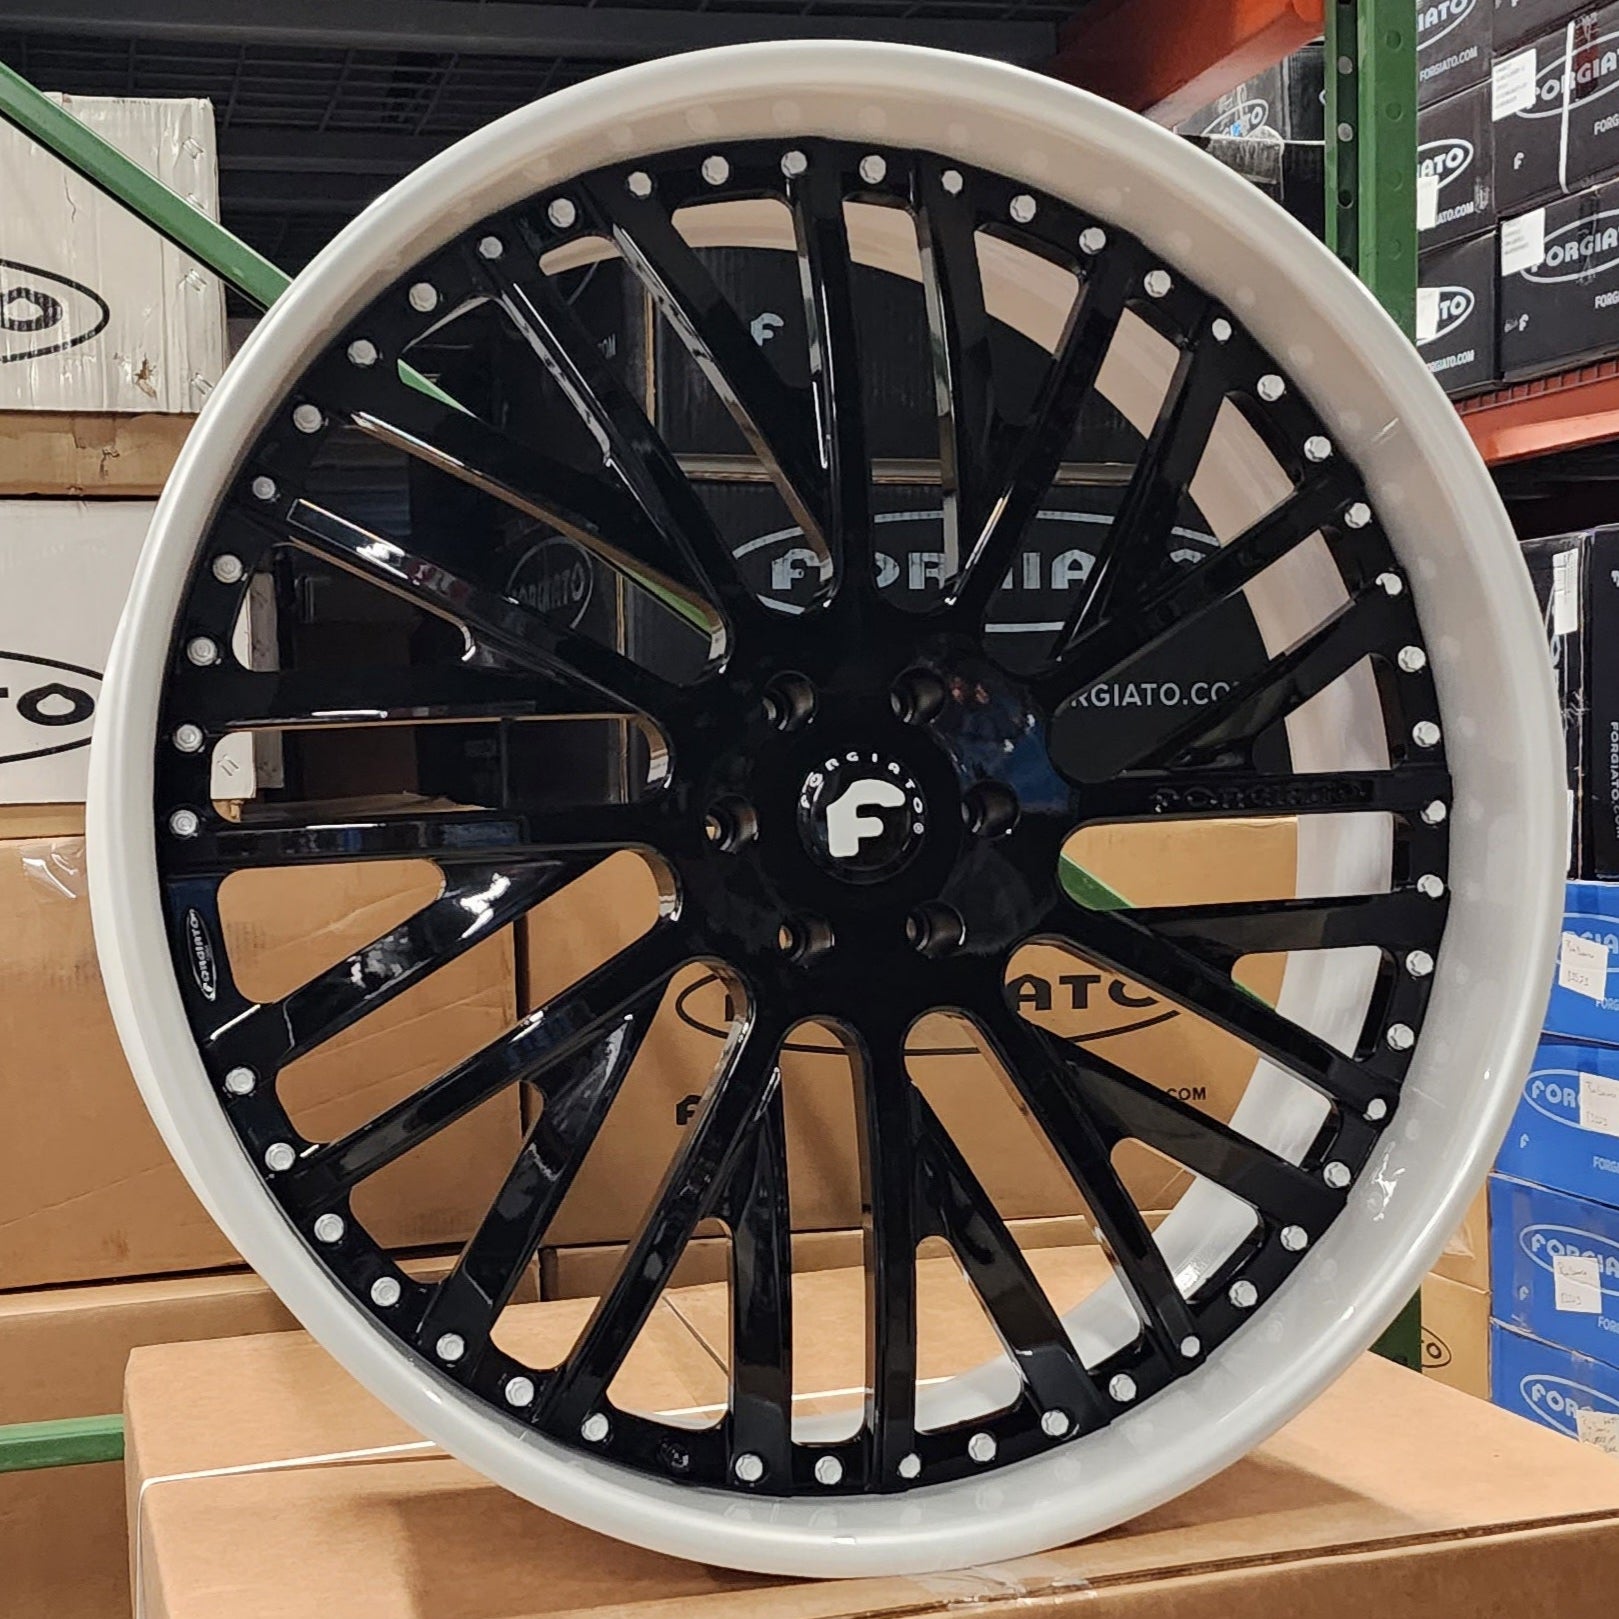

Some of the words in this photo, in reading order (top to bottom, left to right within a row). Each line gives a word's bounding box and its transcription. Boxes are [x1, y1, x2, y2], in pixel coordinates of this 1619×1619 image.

[1436, 201, 1474, 225] ATO.COM
[1531, 227, 1619, 273] ORGIA
[826, 779, 906, 858] F
